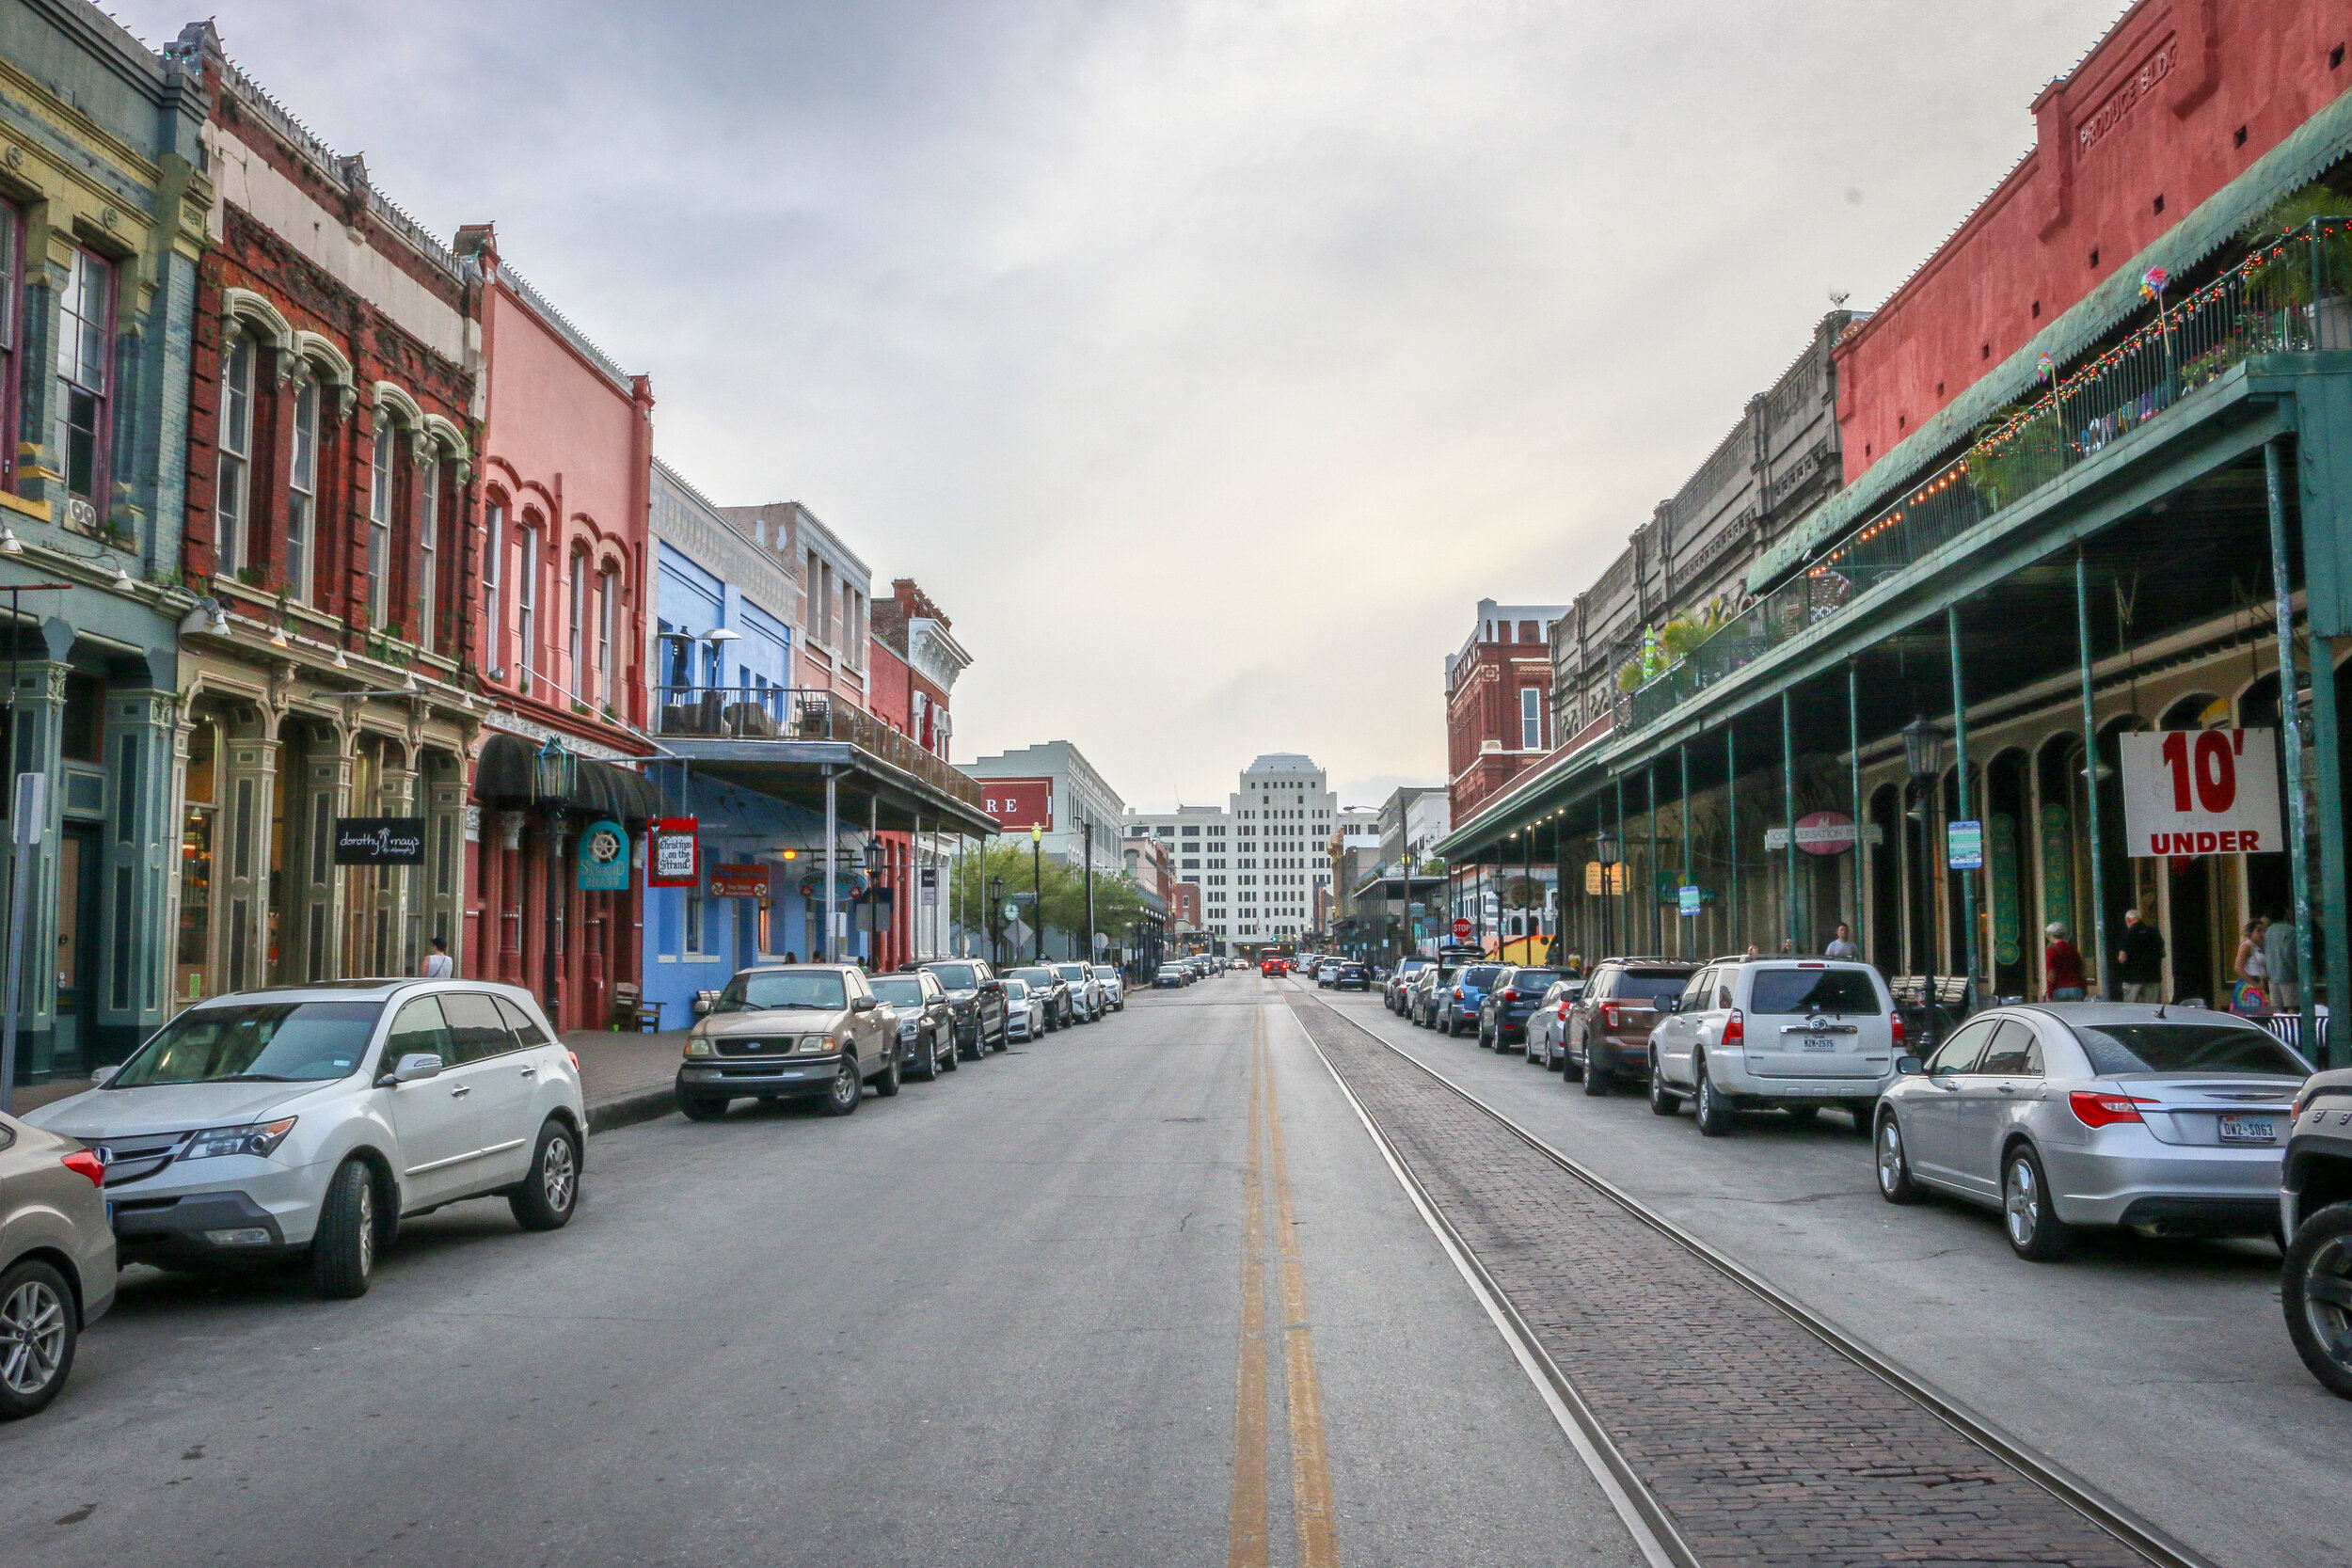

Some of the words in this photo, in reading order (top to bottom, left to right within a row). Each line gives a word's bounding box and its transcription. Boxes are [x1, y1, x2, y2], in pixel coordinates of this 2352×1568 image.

[2080, 79, 2137, 153] PRODUCE
[1772, 829, 1845, 841] COERSATION
[340, 831, 380, 856] dorothy
[390, 836, 420, 855] may's
[2151, 830, 2261, 855] UNDER
[678, 849, 691, 858] the
[660, 857, 691, 870] Strand
[1453, 924, 1471, 932] STOP
